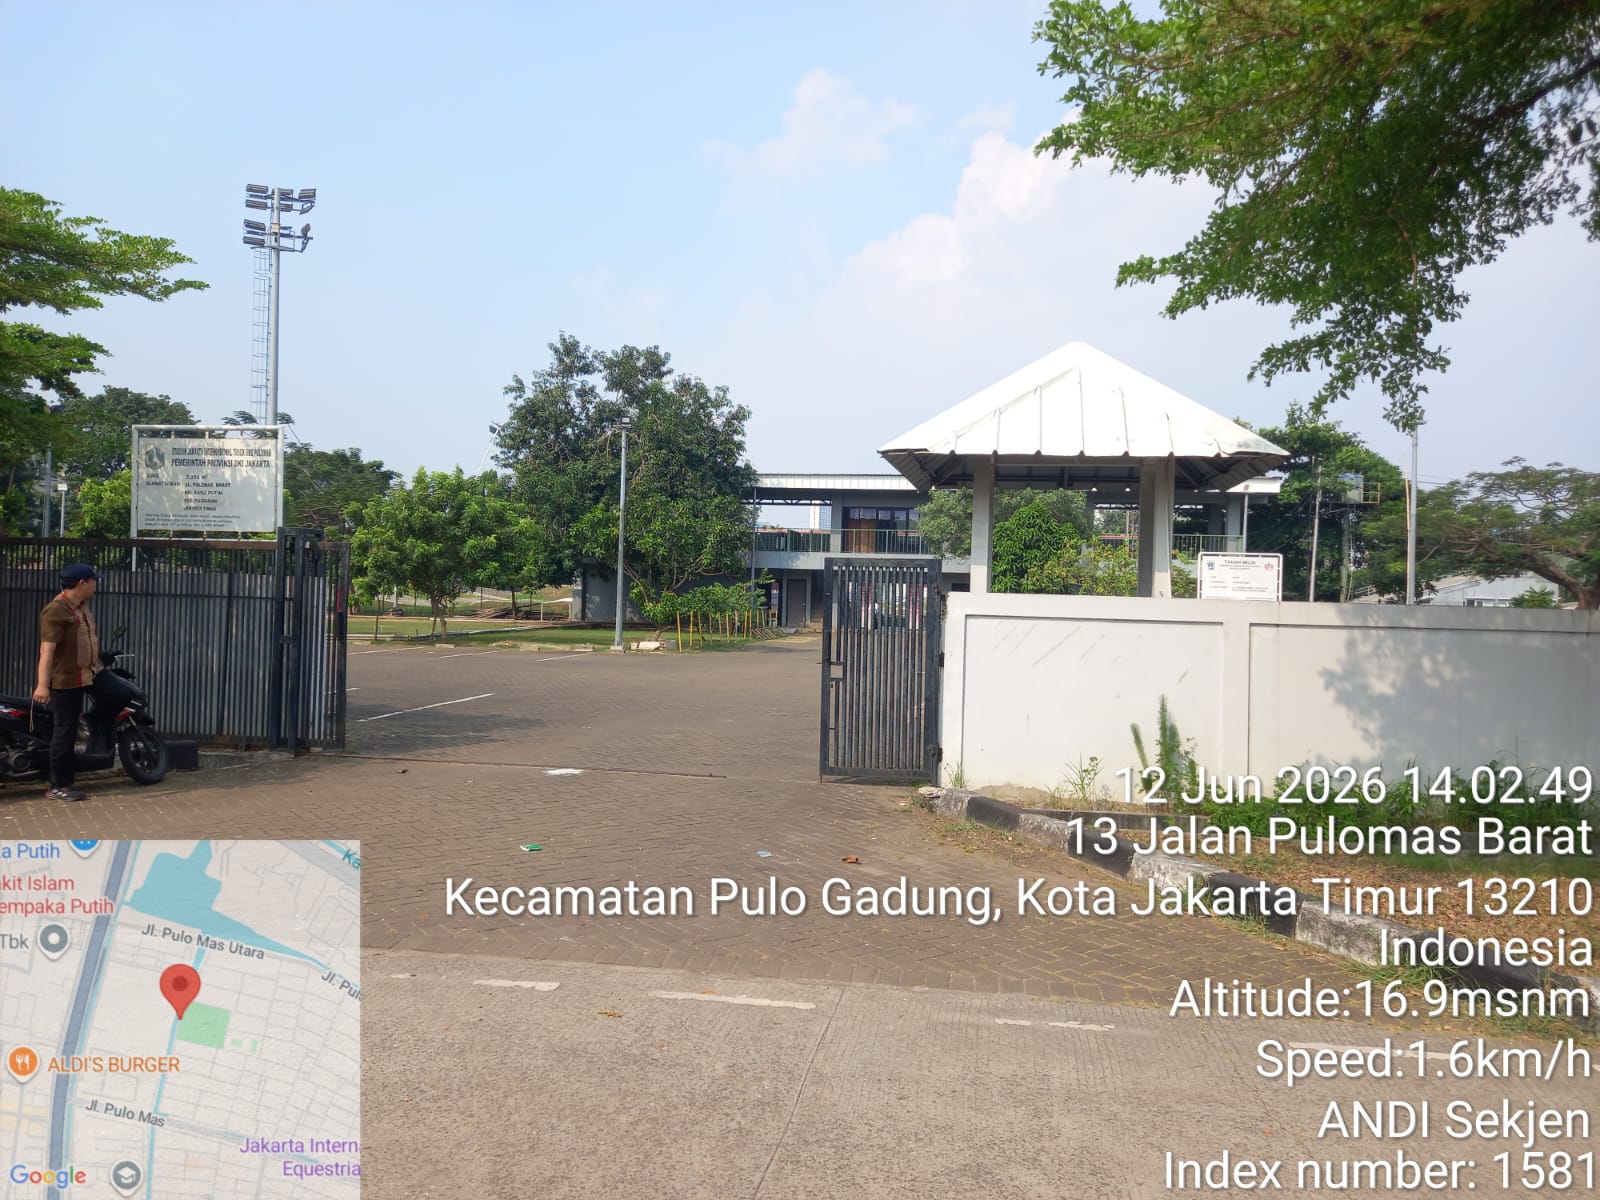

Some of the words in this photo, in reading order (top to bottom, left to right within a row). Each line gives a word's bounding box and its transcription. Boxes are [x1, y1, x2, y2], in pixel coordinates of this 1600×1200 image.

[171, 458, 206, 467] PEMERINTAH
[207, 458, 233, 468] PROVINSI
[233, 459, 243, 468] DKI
[245, 459, 270, 468] JAKARTA
